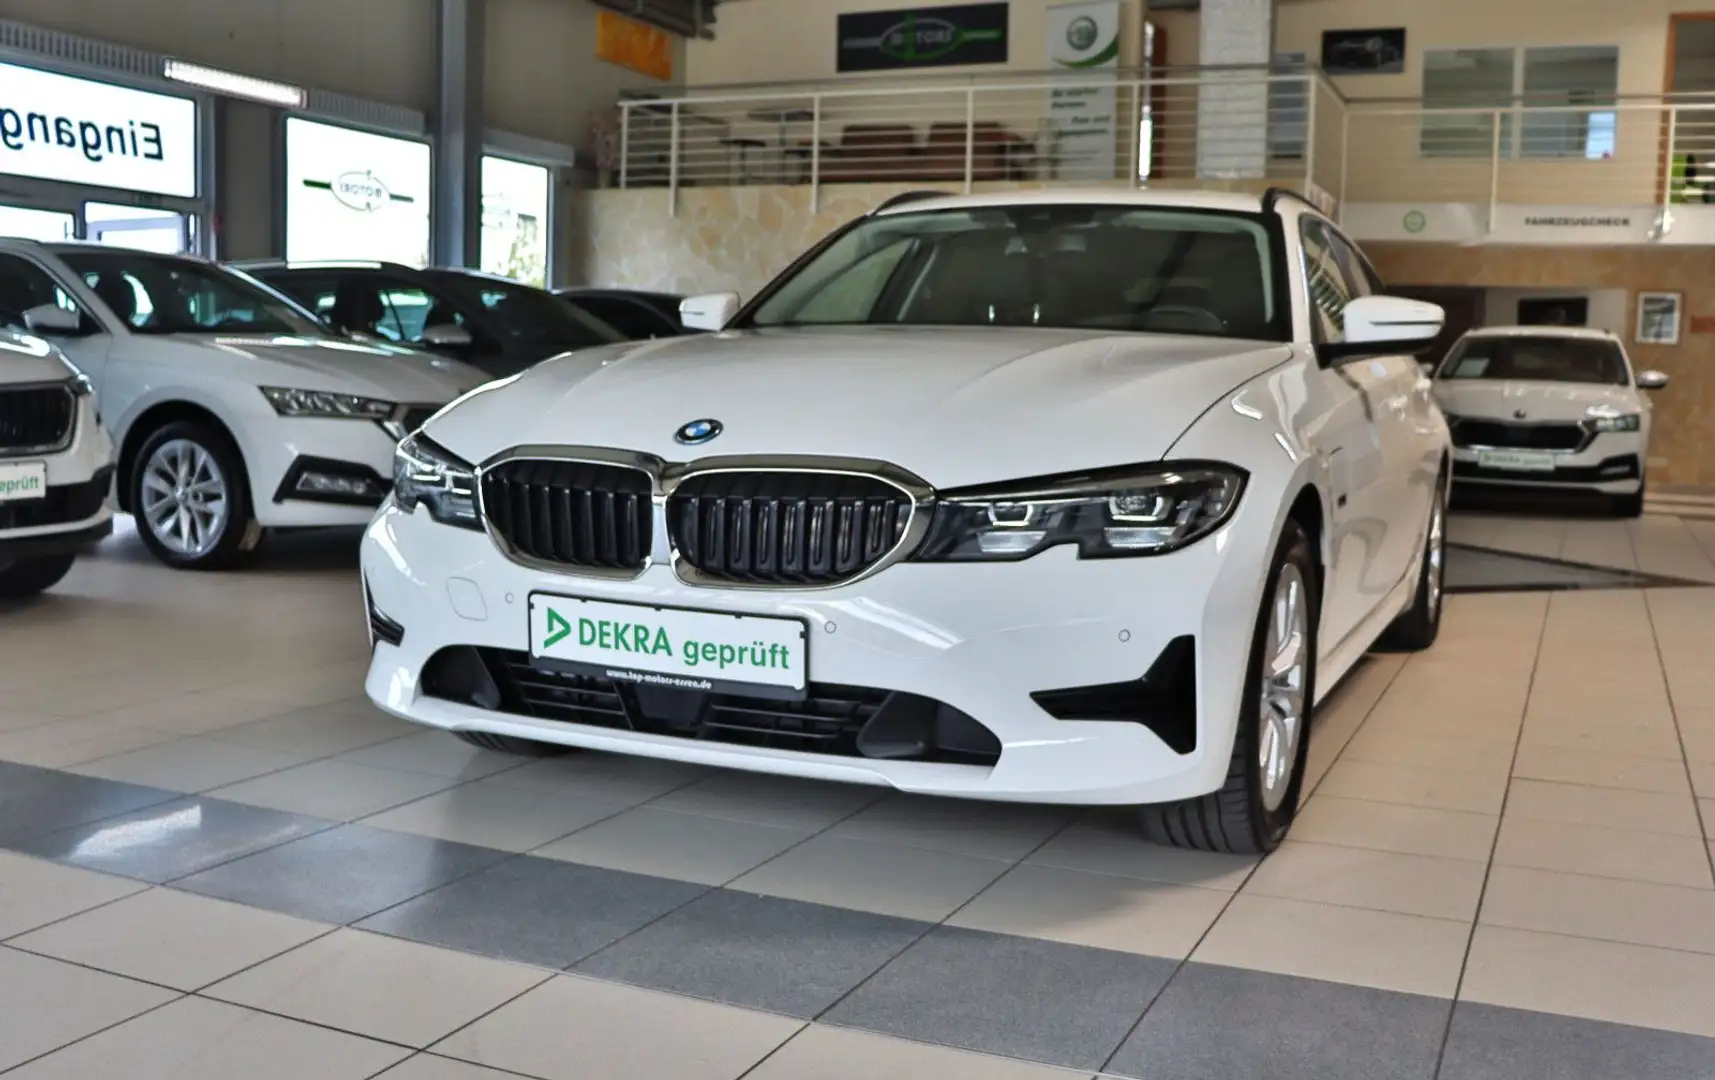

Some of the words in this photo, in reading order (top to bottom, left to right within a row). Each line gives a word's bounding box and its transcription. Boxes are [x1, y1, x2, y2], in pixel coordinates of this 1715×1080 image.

[0, 475, 39, 495] eprüft
[578, 617, 673, 657] DEKRA
[682, 639, 790, 669] geprüft
